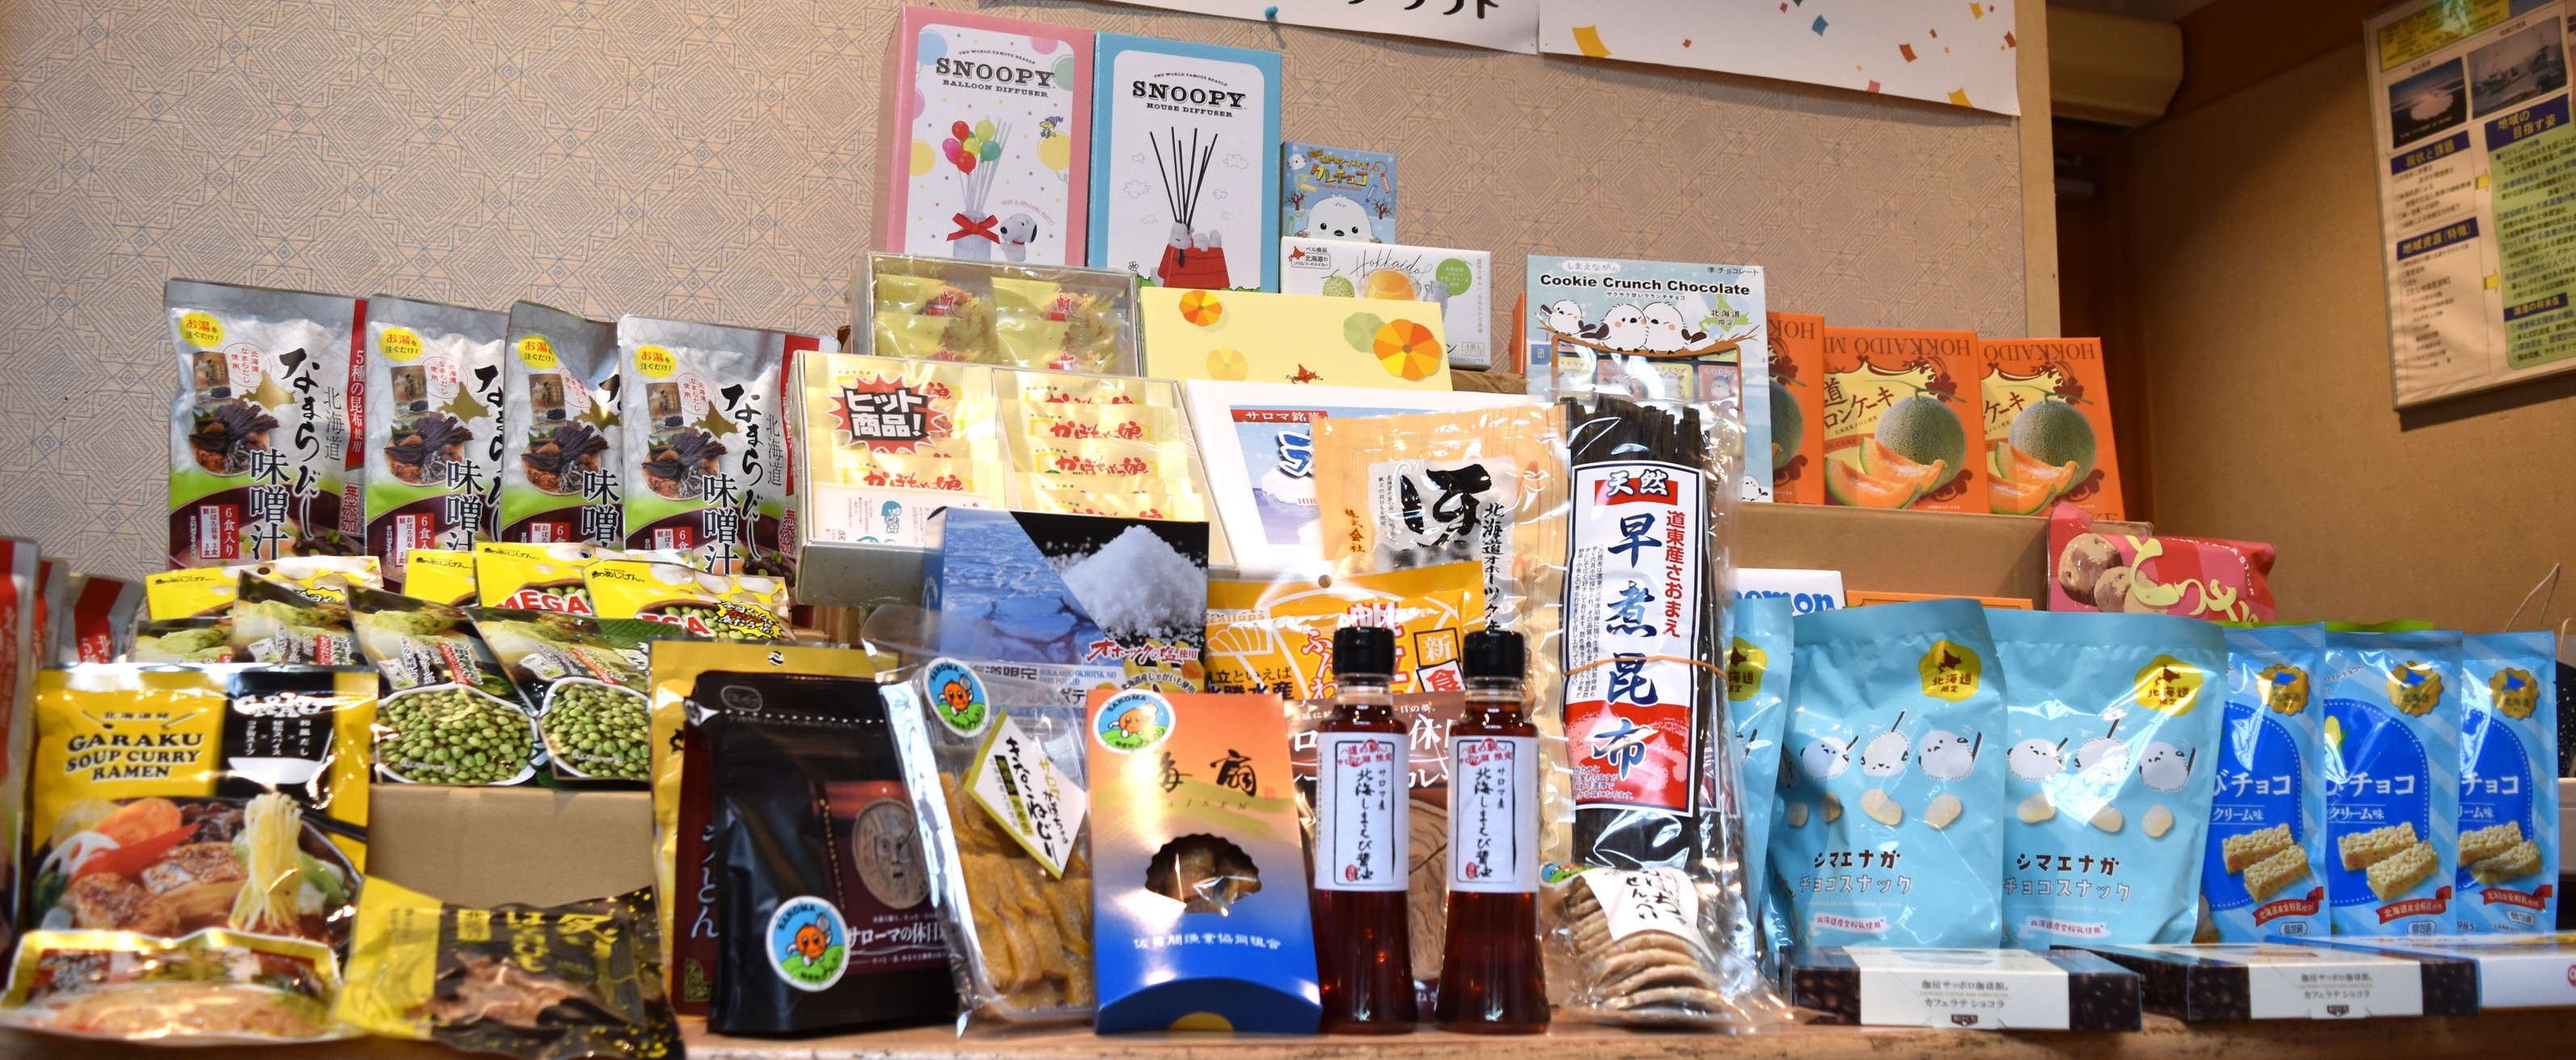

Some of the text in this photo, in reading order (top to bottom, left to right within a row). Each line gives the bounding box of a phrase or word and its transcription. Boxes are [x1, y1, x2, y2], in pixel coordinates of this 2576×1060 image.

[992, 50, 1015, 59] FAMOUS
[1015, 55, 1036, 66] BEAGLE
[936, 57, 1055, 89] SNOOPY
[1185, 73, 1207, 81] FAMOUS
[1208, 77, 1228, 87] BEAGLE
[942, 79, 1048, 98] BALLOON DIFFUSER
[1132, 80, 1246, 110] SNOOPY
[1147, 103, 1233, 118] HOUSE DIFFUSER
[1304, 254, 1329, 263] 北海道の
[1306, 245, 1328, 254] ベル食品
[1350, 249, 1433, 279] Hokkaido
[1567, 262, 1618, 272] しまえながの
[1718, 267, 1760, 276] チョコレート
[1540, 274, 1751, 295] Cookie Crunch Chocolate
[1606, 291, 1686, 301] サクサク甘いクランチチョコ
[1710, 309, 1741, 319] 北海道
[186, 319, 217, 334] お湯を
[385, 333, 417, 347] お湯を
[1854, 338, 1970, 356] HOKKAIDO
[640, 348, 672, 363] お湯を
[1984, 344, 2095, 361] HOKKAIDO
[846, 389, 923, 413] ヒット
[323, 386, 346, 461] 北海道
[279, 347, 321, 540] なまらだし
[766, 413, 783, 486] 北海道
[720, 383, 764, 559] なまらだし
[1605, 470, 1669, 497] 天然
[250, 448, 292, 560] 味噌汁
[341, 484, 359, 534] 無添加
[445, 459, 485, 552] 味噌汁
[224, 507, 235, 557] 6食入り
[702, 473, 740, 575] 味噌汁
[779, 508, 798, 555] 無添加
[1662, 509, 1685, 639] 道東産さおまえ
[1592, 513, 1663, 783] 早煮昆布
[930, 663, 959, 683] SAROMA
[1121, 670, 1197, 693] 北海道産じゃがいも使用
[1932, 672, 1973, 686] 北海道
[2147, 685, 2189, 699] 北海道
[1107, 695, 1147, 713] SAROMA
[68, 733, 203, 752] GARAKU
[66, 749, 201, 773] SOUP CURRY
[91, 766, 170, 783] RAMEN
[1355, 769, 1375, 881] 北海しまえび醤油
[1475, 768, 1496, 879] 北海しまえび醤油
[1814, 848, 1902, 870] シマエナガ
[2016, 853, 2121, 876] シマエナガ
[1800, 874, 1913, 895] チョコスナック
[2003, 877, 2131, 902] チョコスナック
[778, 903, 816, 932] SAROMA
[2410, 921, 2433, 934] 個包装
[2282, 923, 2305, 935] 個包装
[1971, 999, 2005, 1008] ショコラ
